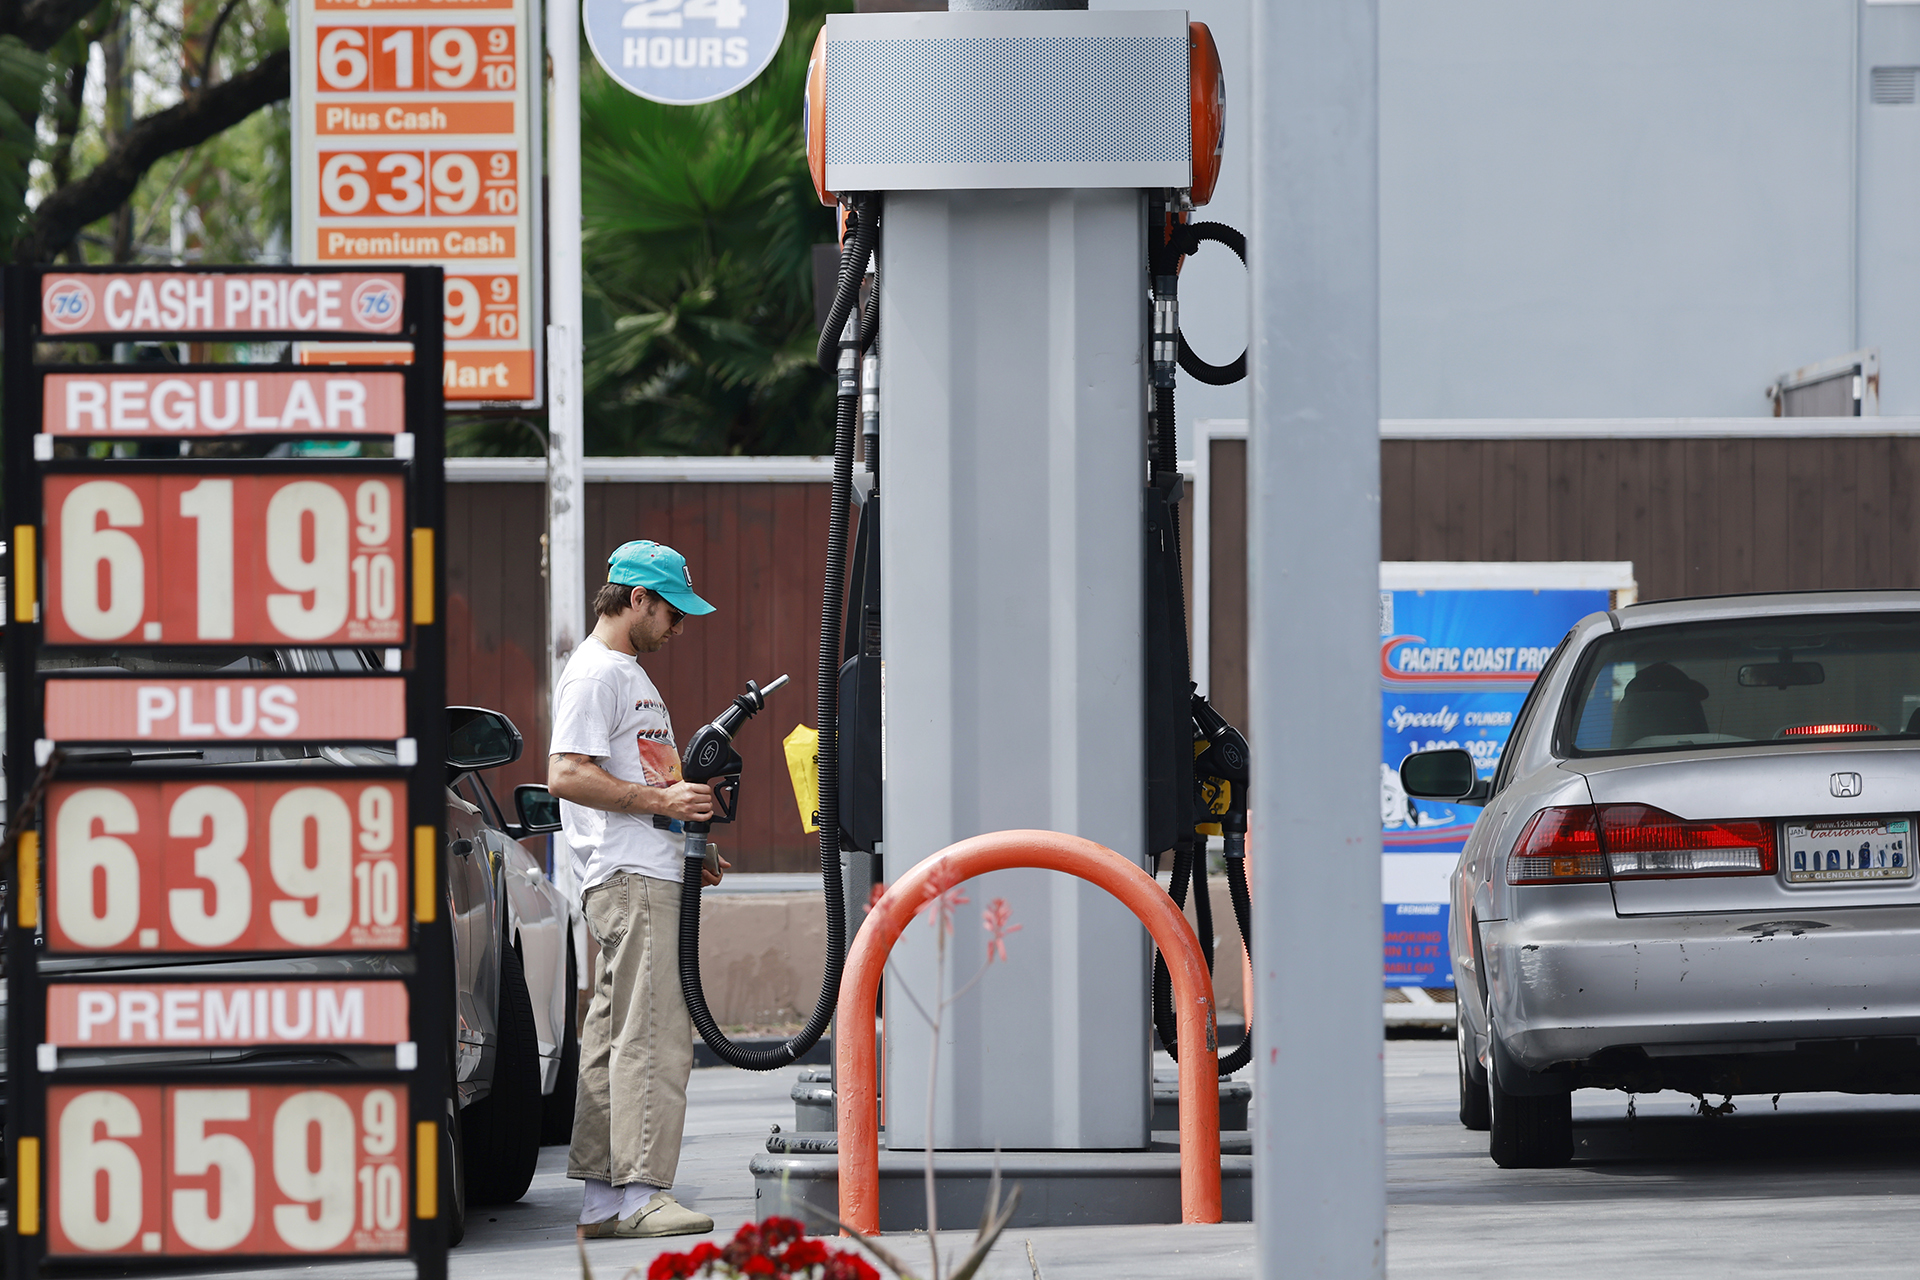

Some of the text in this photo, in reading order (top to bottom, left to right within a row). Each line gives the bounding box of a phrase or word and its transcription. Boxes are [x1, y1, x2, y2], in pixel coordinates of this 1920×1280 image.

[621, 0, 747, 29] 24
[622, 37, 749, 68] HOURS
[326, 107, 447, 130] Plus Cash
[328, 231, 506, 255] Premium Cash
[54, 279, 391, 330] 76 CASH PRICE 76
[66, 379, 367, 431] REGULAR
[61, 479, 350, 641] 6.19
[1399, 646, 1556, 672] PACIFIC COAST PRO
[136, 685, 300, 737] PLUS
[1387, 705, 1512, 733] Speedy CYLINDER
[701, 744, 715, 762] VST
[1816, 820, 1878, 828] www.123kia.com
[56, 786, 353, 948] 6.39
[1815, 871, 1860, 880] GLENDALE
[1863, 869, 1884, 878] KIA
[77, 990, 364, 1041] PREMIUM
[59, 1089, 357, 1251] 6.59
